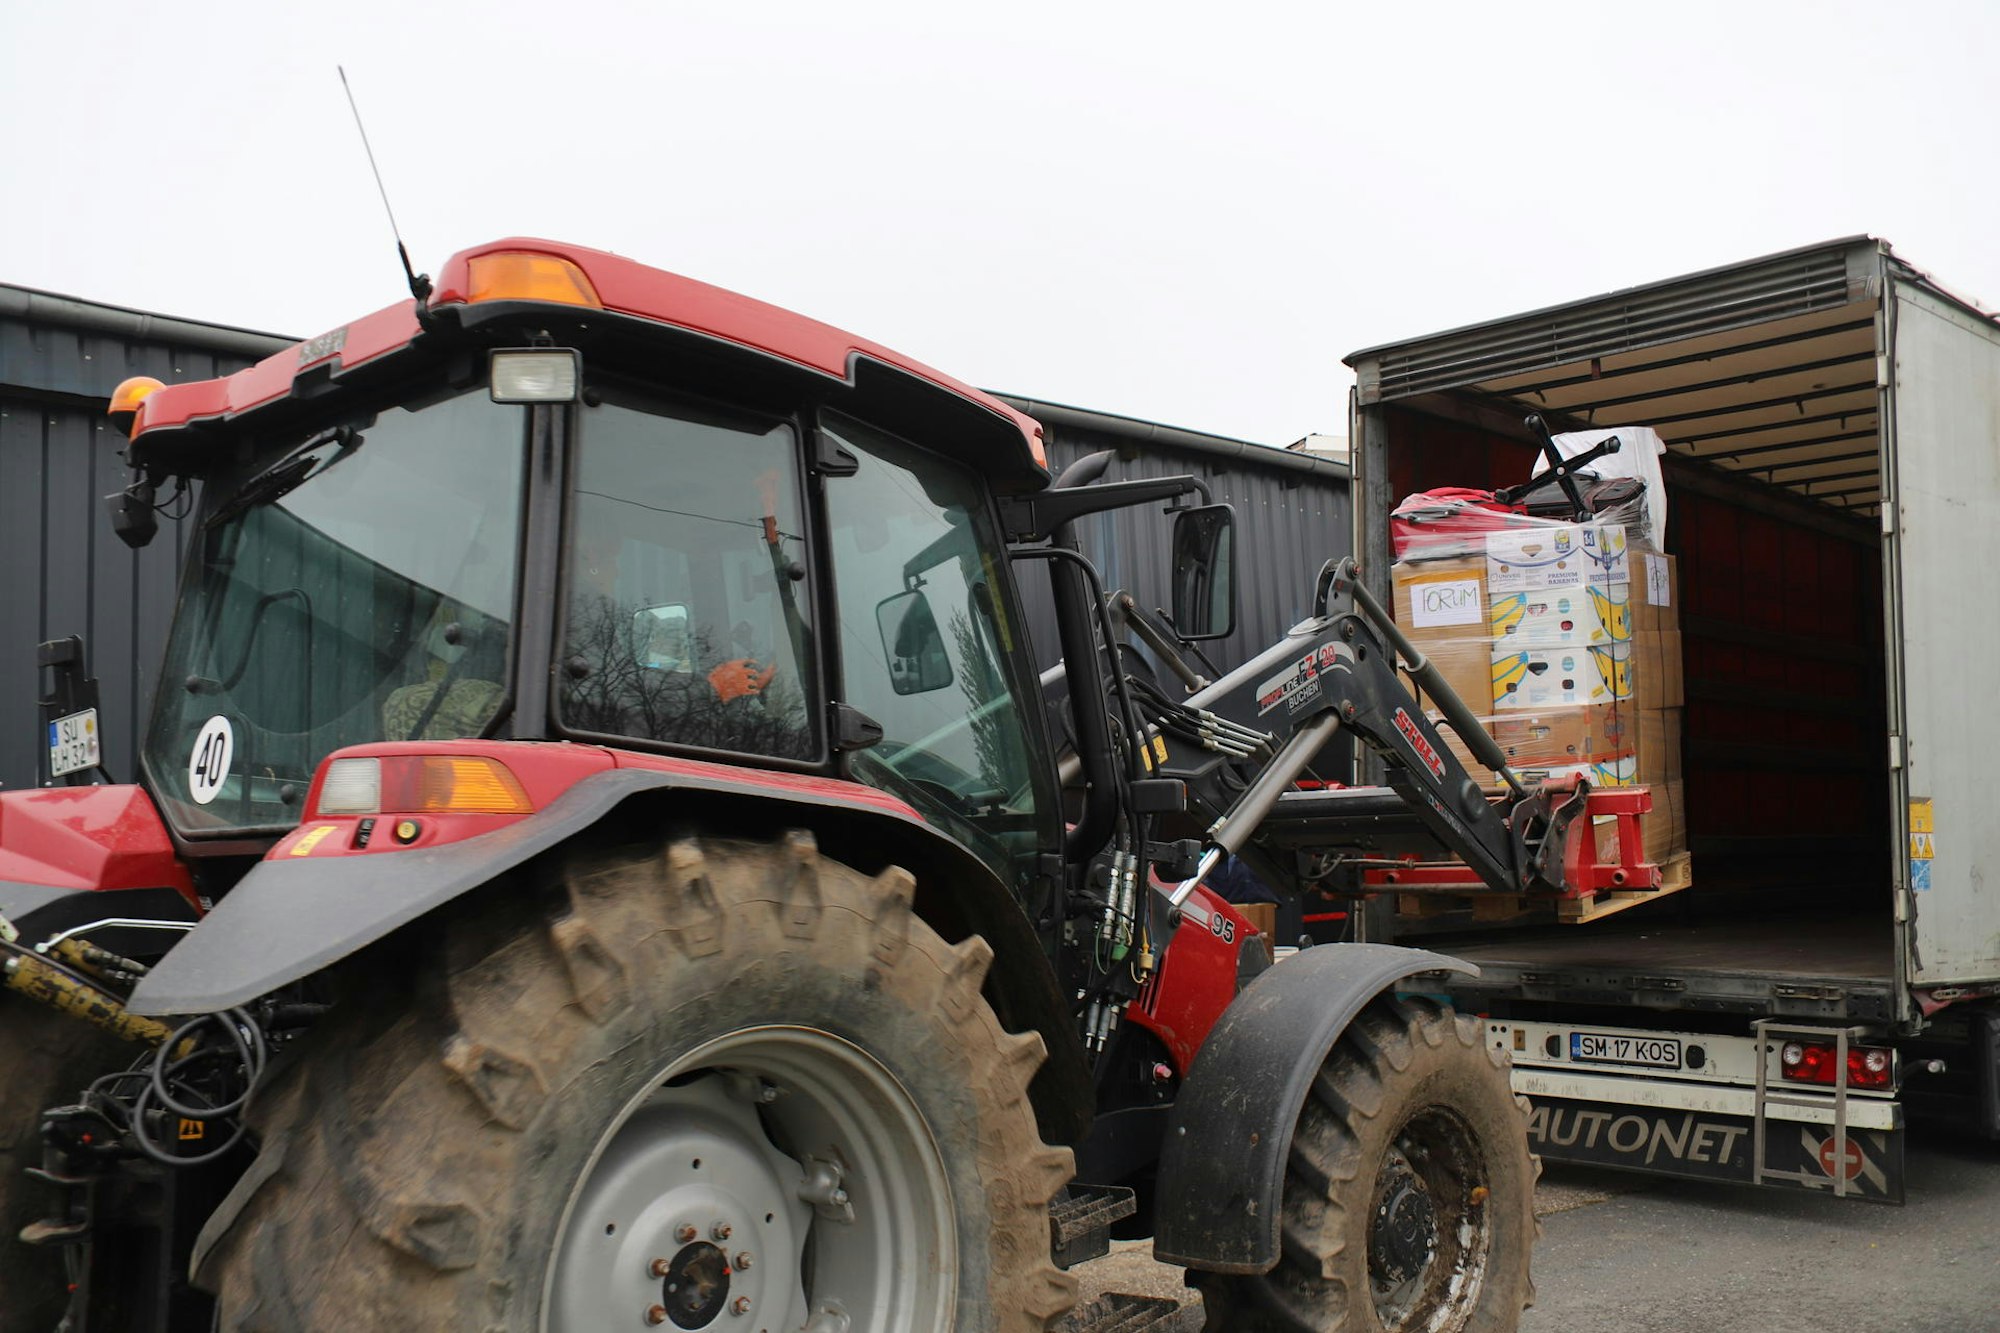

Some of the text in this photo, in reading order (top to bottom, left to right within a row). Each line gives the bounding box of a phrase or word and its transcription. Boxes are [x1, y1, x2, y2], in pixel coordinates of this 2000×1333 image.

[1547, 571, 1578, 579] PREMIUM
[1288, 681, 1320, 709] BUCHEN
[63, 718, 78, 744] SU
[1394, 710, 1441, 777] STOLL
[72, 742, 86, 767] 32
[195, 731, 225, 788] 40
[1211, 911, 1236, 944] 95
[1582, 1037, 1607, 1057] SM
[1614, 1039, 1630, 1059] 17
[1636, 1041, 1676, 1062] KOS
[1526, 1106, 1749, 1165] AUTONET
